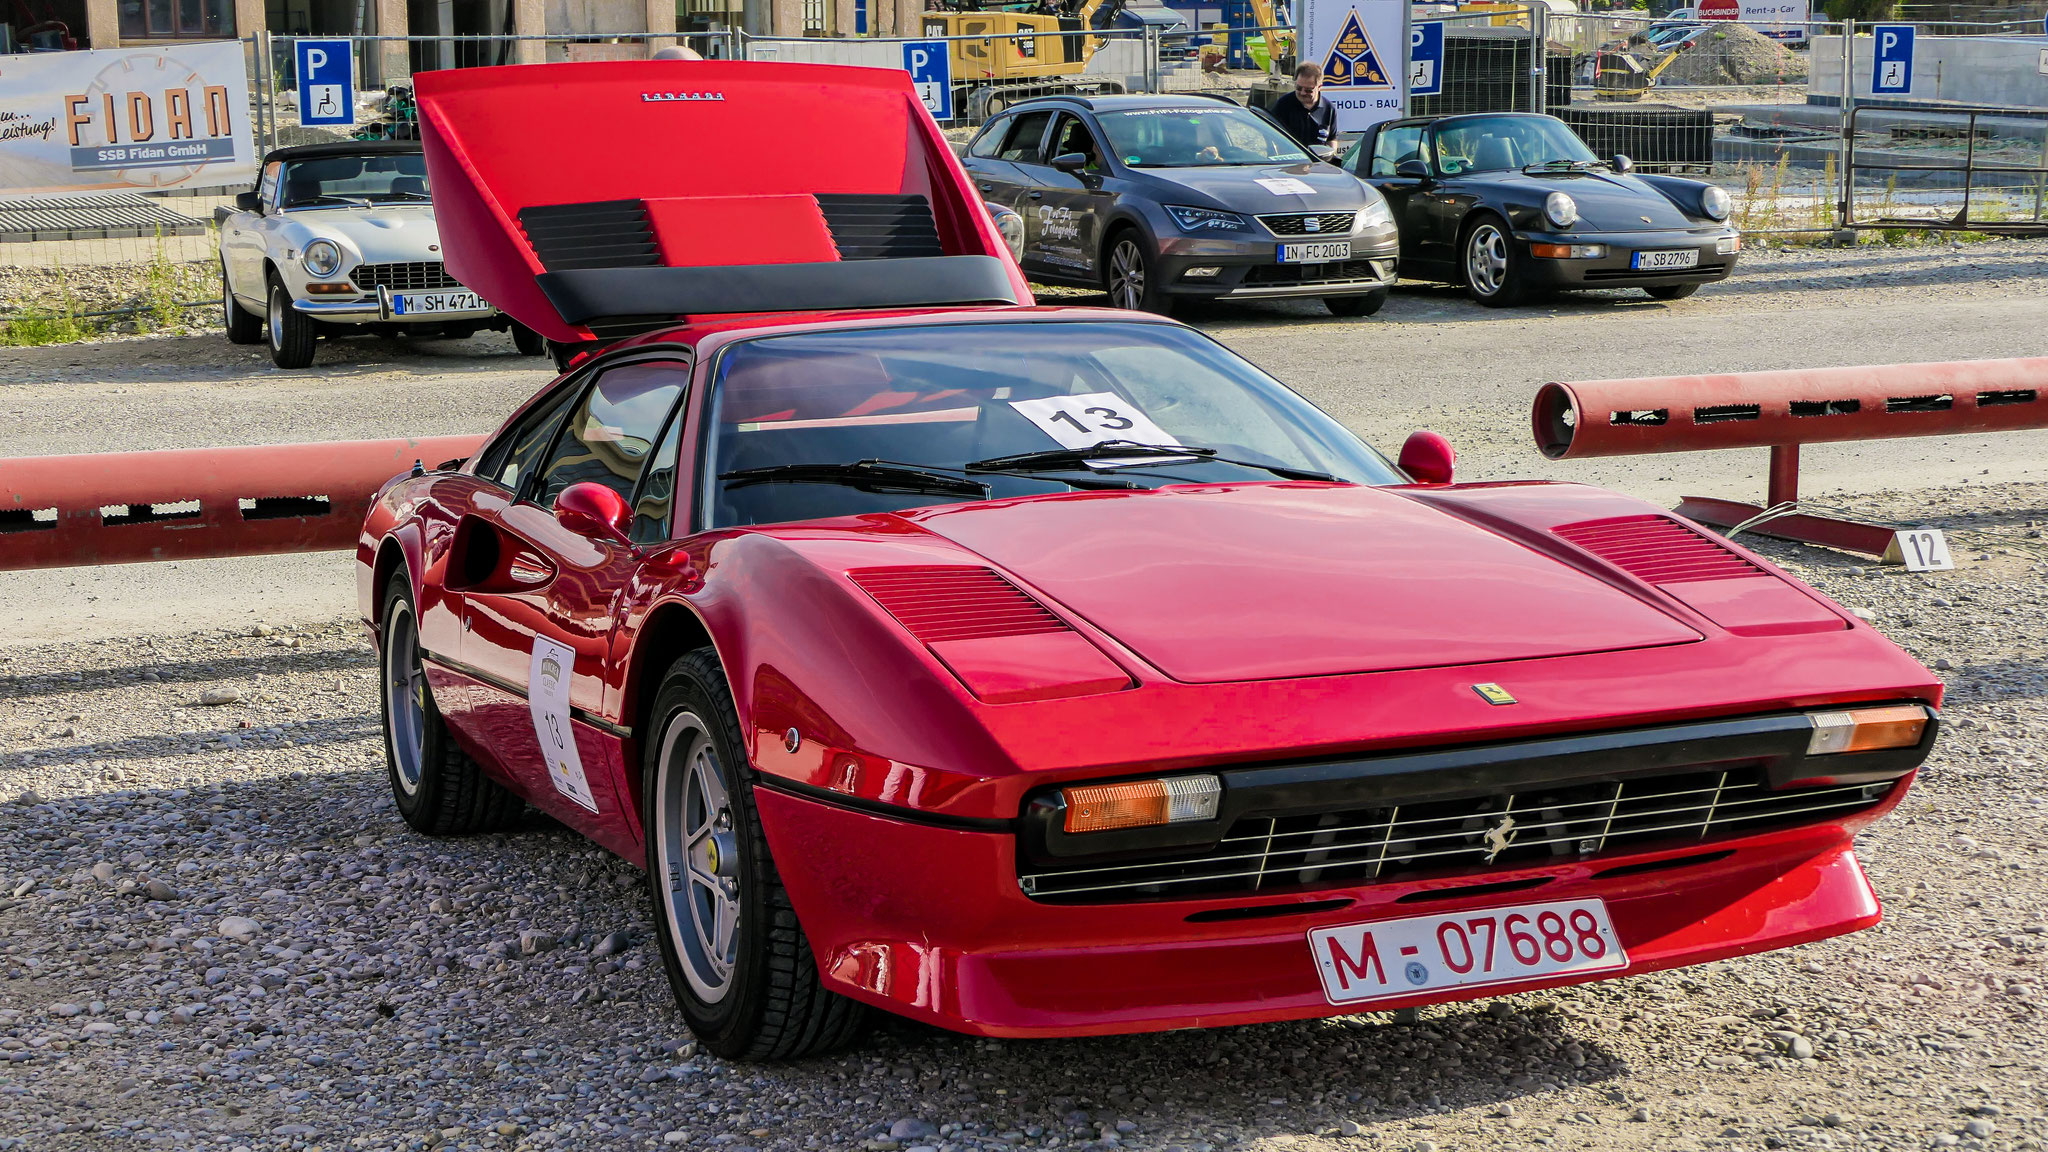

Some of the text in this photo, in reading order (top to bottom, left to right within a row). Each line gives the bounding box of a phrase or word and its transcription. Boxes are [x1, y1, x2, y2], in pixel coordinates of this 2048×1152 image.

[1699, 8, 1739, 16] BUCHBINDER
[926, 25, 943, 37] CAT
[1411, 25, 1424, 56] P
[1881, 32, 1898, 57] P
[307, 49, 327, 80] P
[911, 49, 929, 78] P
[64, 85, 232, 146] FIDAN
[1330, 99, 1366, 110] HOLD
[1377, 99, 1398, 109] BAU
[0, 117, 56, 140] eistung!
[98, 144, 207, 161] SSB Fidan GmbH
[1286, 243, 1348, 259] IN FC 2003
[1640, 254, 1646, 267] M
[1654, 253, 1666, 266] SB
[1668, 252, 1691, 266] 2796
[404, 297, 414, 312] M
[425, 295, 445, 310] SH
[1049, 406, 1134, 434] 13
[1908, 533, 1942, 566] 12
[544, 710, 564, 750] 13
[1327, 931, 1387, 990] M
[1436, 908, 1607, 975] 07688
